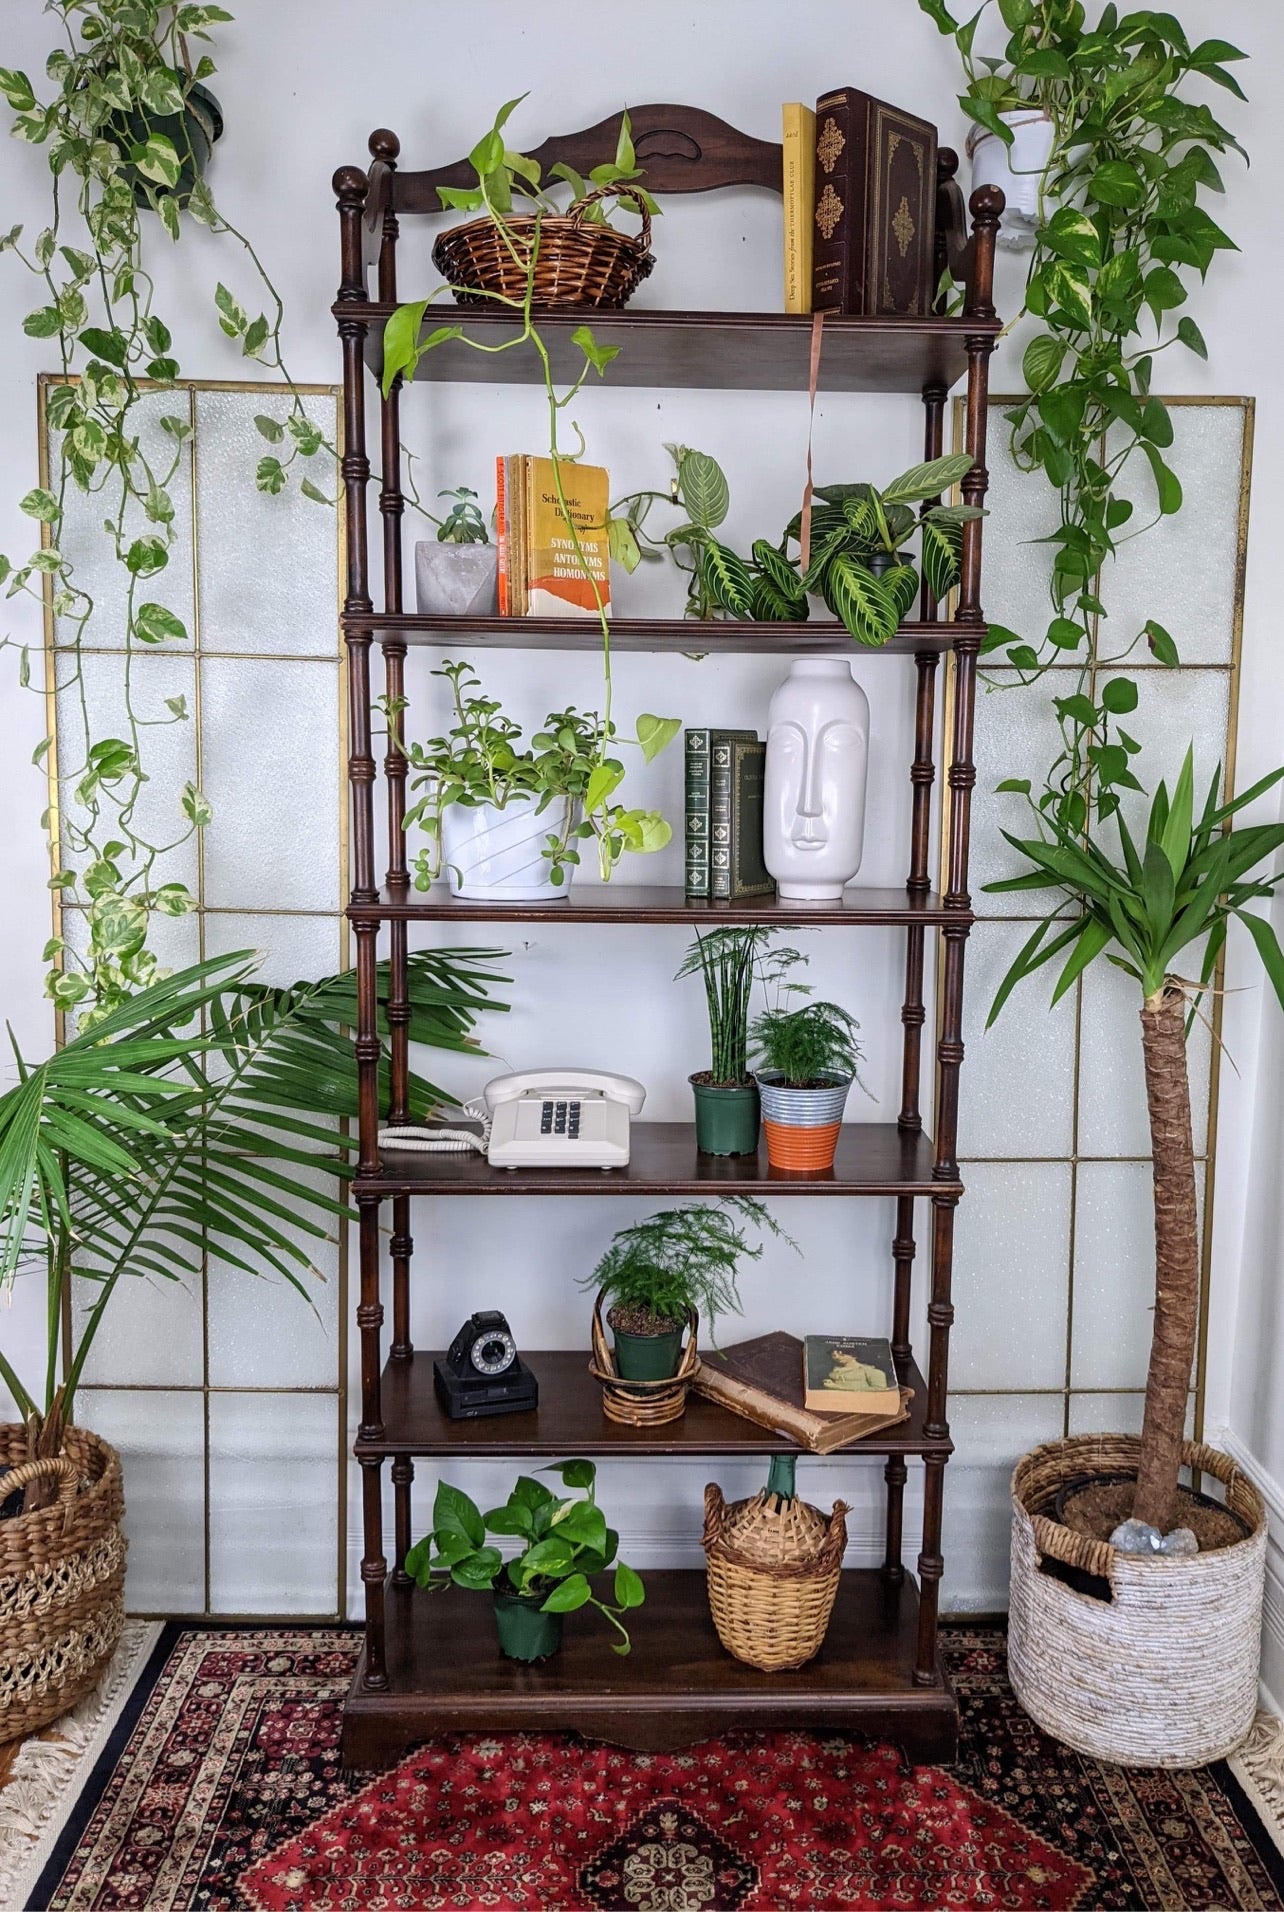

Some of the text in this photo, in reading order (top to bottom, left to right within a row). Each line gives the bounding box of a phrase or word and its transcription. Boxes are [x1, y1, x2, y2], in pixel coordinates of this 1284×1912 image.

[541, 493, 581, 507] Schoastic
[555, 508, 594, 523] Ditionary
[551, 538, 599, 553] SYNOYMS
[554, 553, 602, 567] ANTOYMS
[553, 567, 606, 581] HOMONMS
